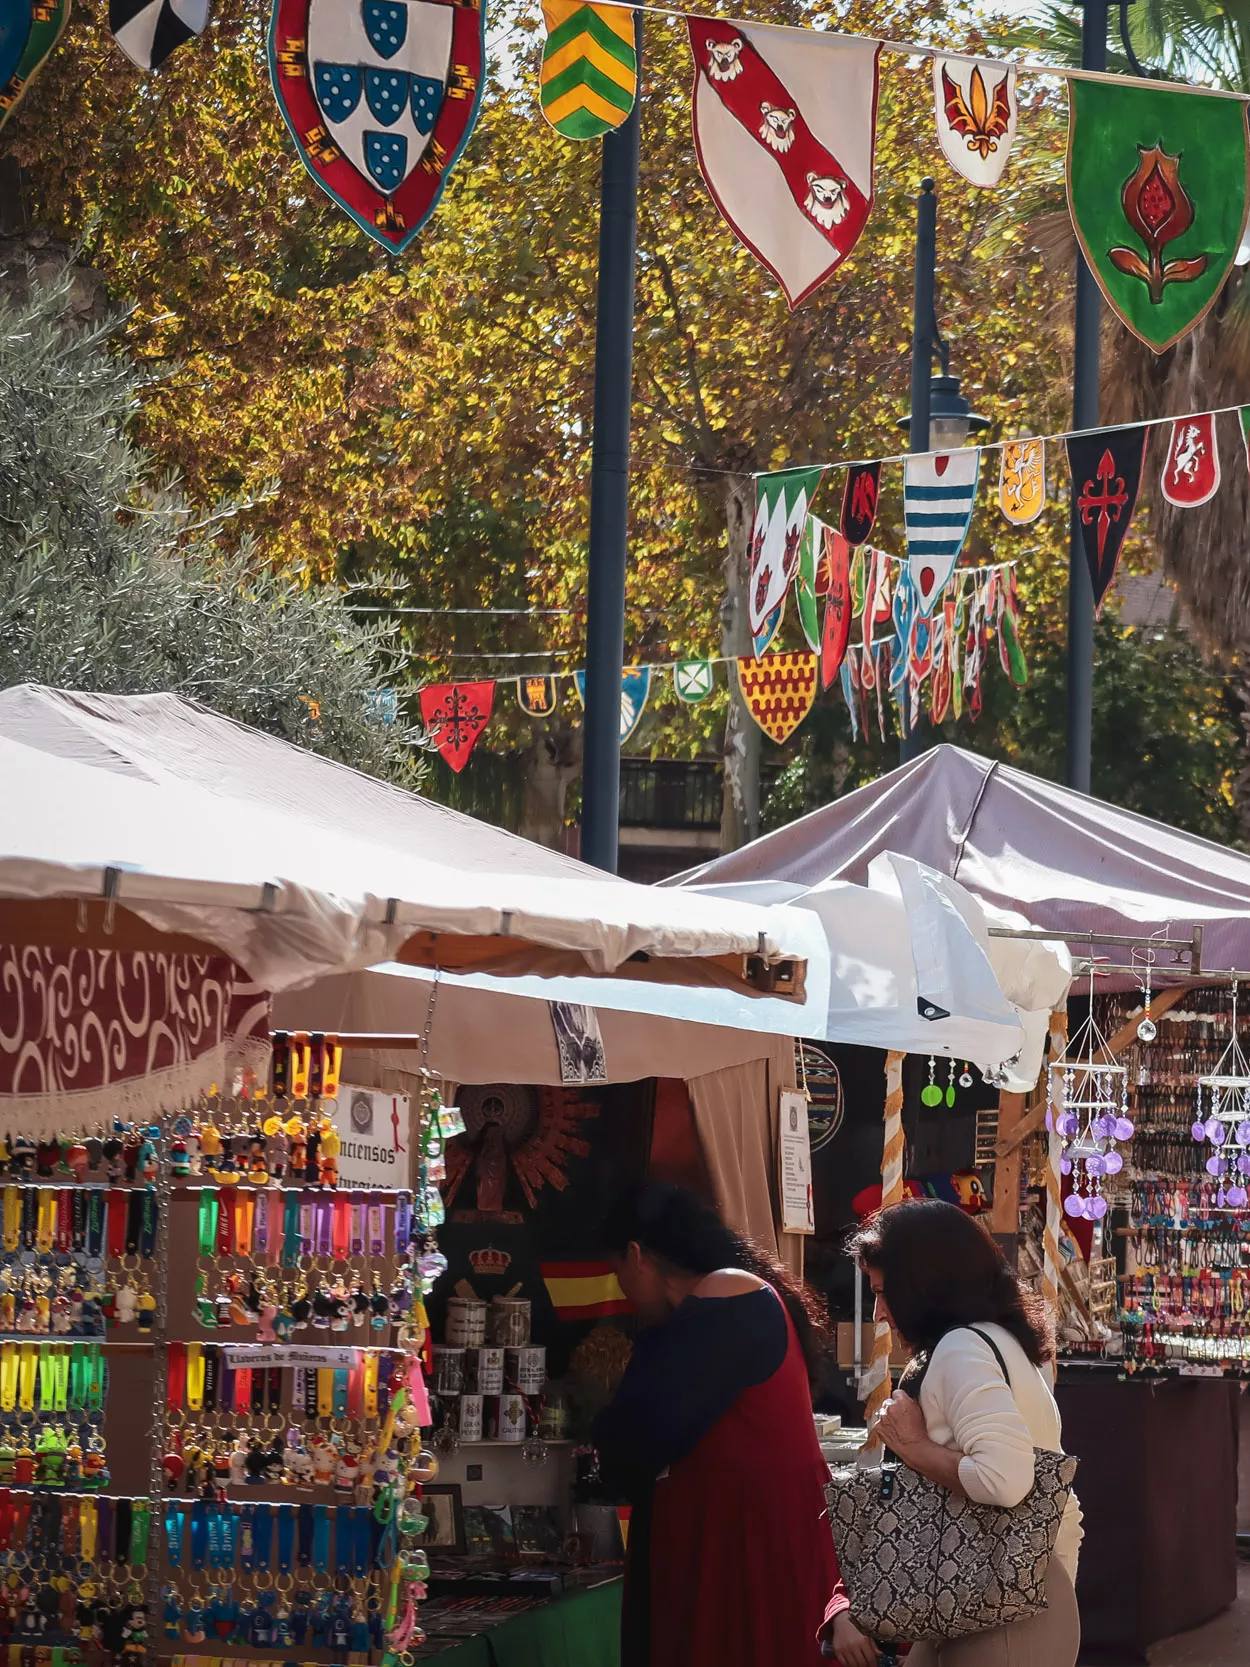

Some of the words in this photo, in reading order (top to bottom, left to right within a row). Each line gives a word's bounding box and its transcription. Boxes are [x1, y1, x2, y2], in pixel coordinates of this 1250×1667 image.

[339, 1140, 396, 1165] nciensos
[219, 1208, 229, 1236] NIKE
[273, 1352, 285, 1361] de
[206, 1359, 214, 1391] Villains
